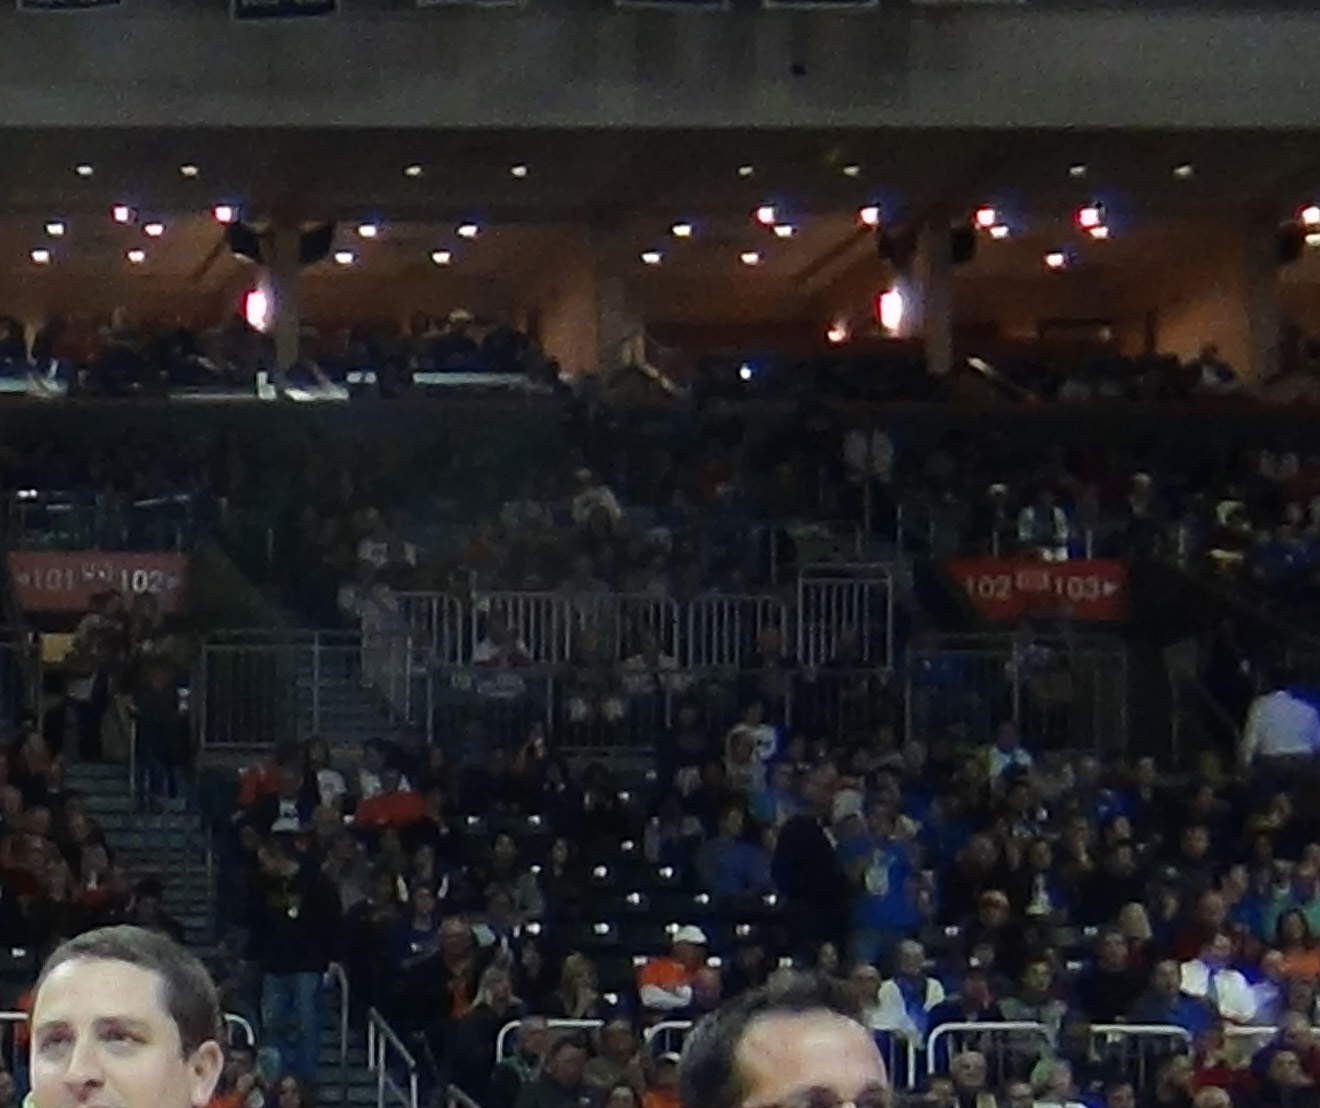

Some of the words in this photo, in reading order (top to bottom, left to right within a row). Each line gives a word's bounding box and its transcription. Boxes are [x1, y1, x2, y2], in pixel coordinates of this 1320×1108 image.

[33, 567, 74, 591] 101
[121, 569, 163, 593] 102
[966, 573, 1009, 598] 102
[1054, 574, 1099, 601] 103
